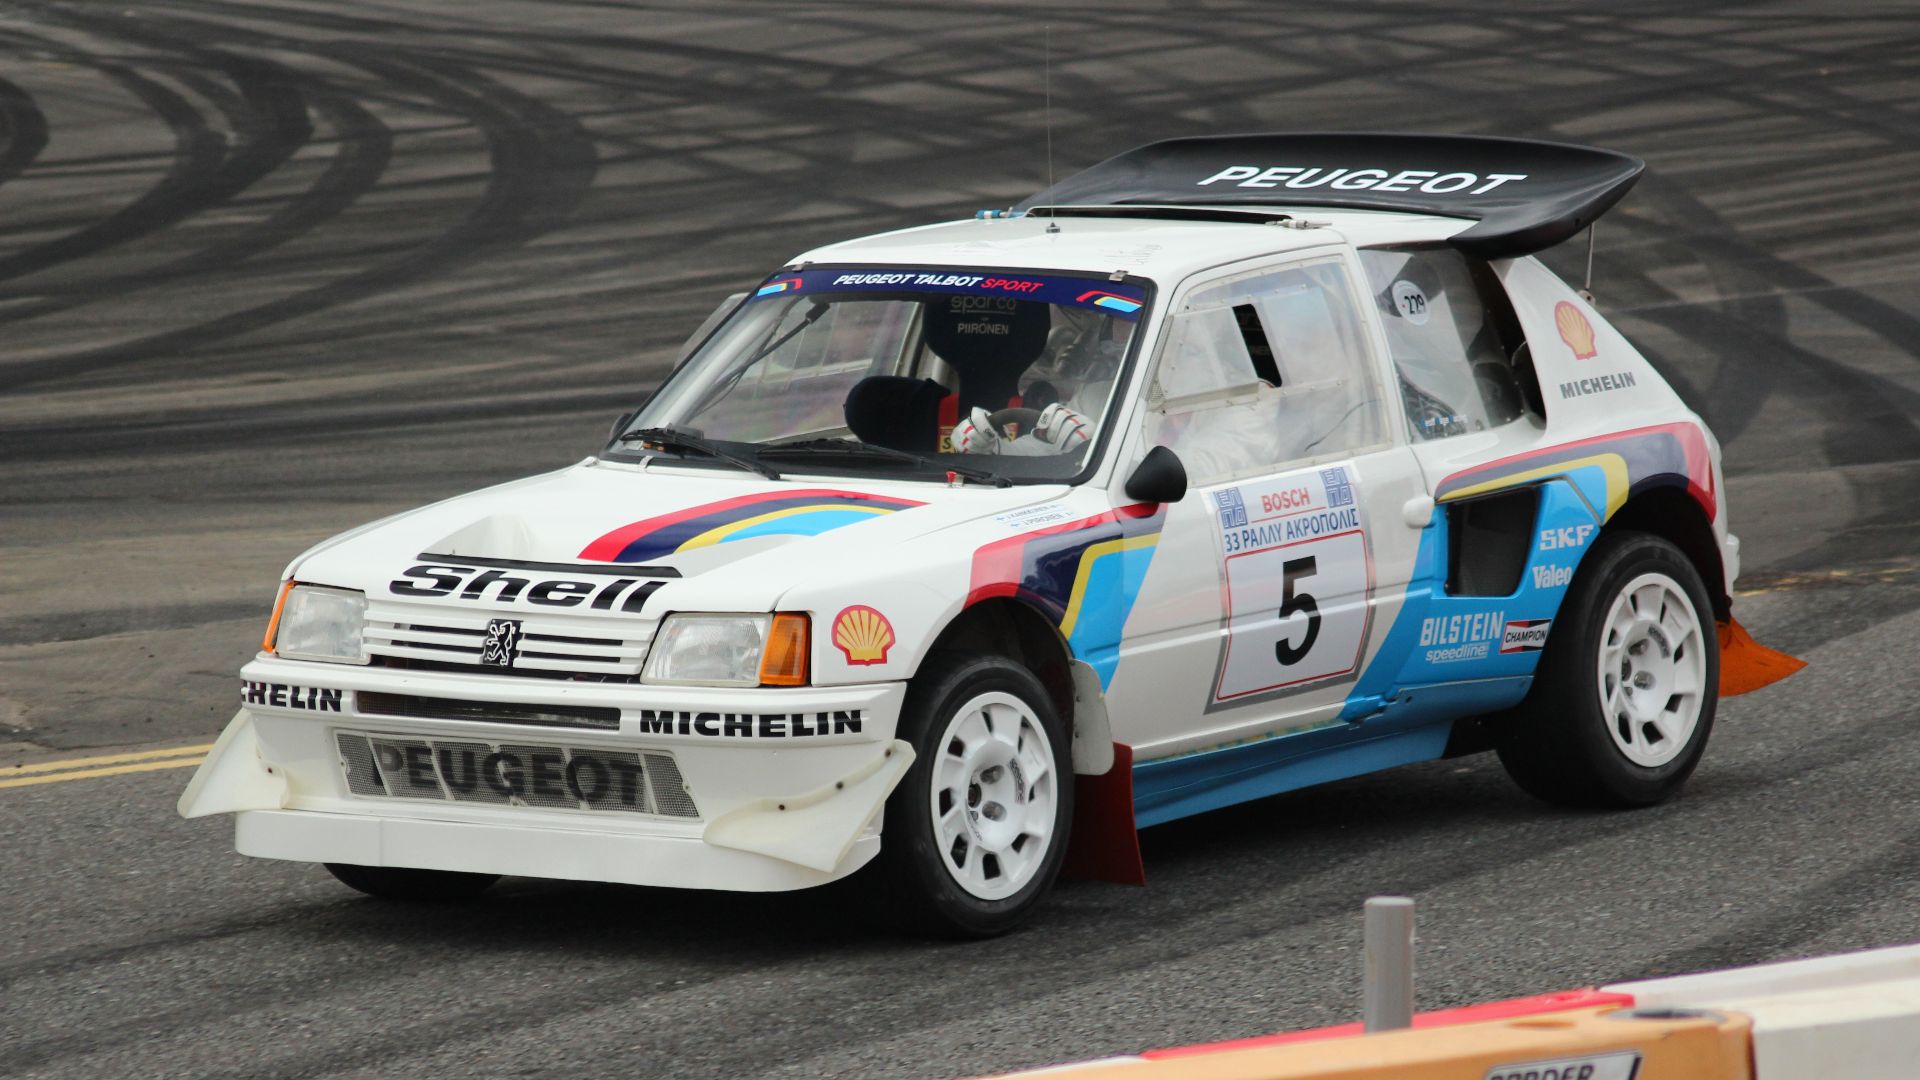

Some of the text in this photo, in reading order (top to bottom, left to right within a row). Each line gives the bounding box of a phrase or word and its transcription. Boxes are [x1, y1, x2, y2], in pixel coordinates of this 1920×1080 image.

[1198, 166, 1528, 195] PEUGEOT
[833, 273, 1043, 293] PEUGEOT TALBOT SPORT
[951, 295, 1017, 314] sparco
[957, 322, 1009, 335] PIIRONEN
[1560, 371, 1636, 399] MICHELIN
[1261, 487, 1311, 514] BOSCH
[1225, 508, 1359, 553] 33 ΡΑΛΛΥ ΑΚΡΟΠΟΛΙΣ
[1539, 524, 1594, 551] SKF
[389, 563, 668, 613] Shell
[1532, 563, 1572, 590] Valeo
[1275, 555, 1322, 666] 5
[1419, 610, 1504, 647] BILSTEIN
[1504, 629, 1548, 644] CHAMPION
[1425, 643, 1488, 663] speedline
[640, 709, 862, 738] MICHELIN
[370, 742, 645, 808] PEUGEOT
